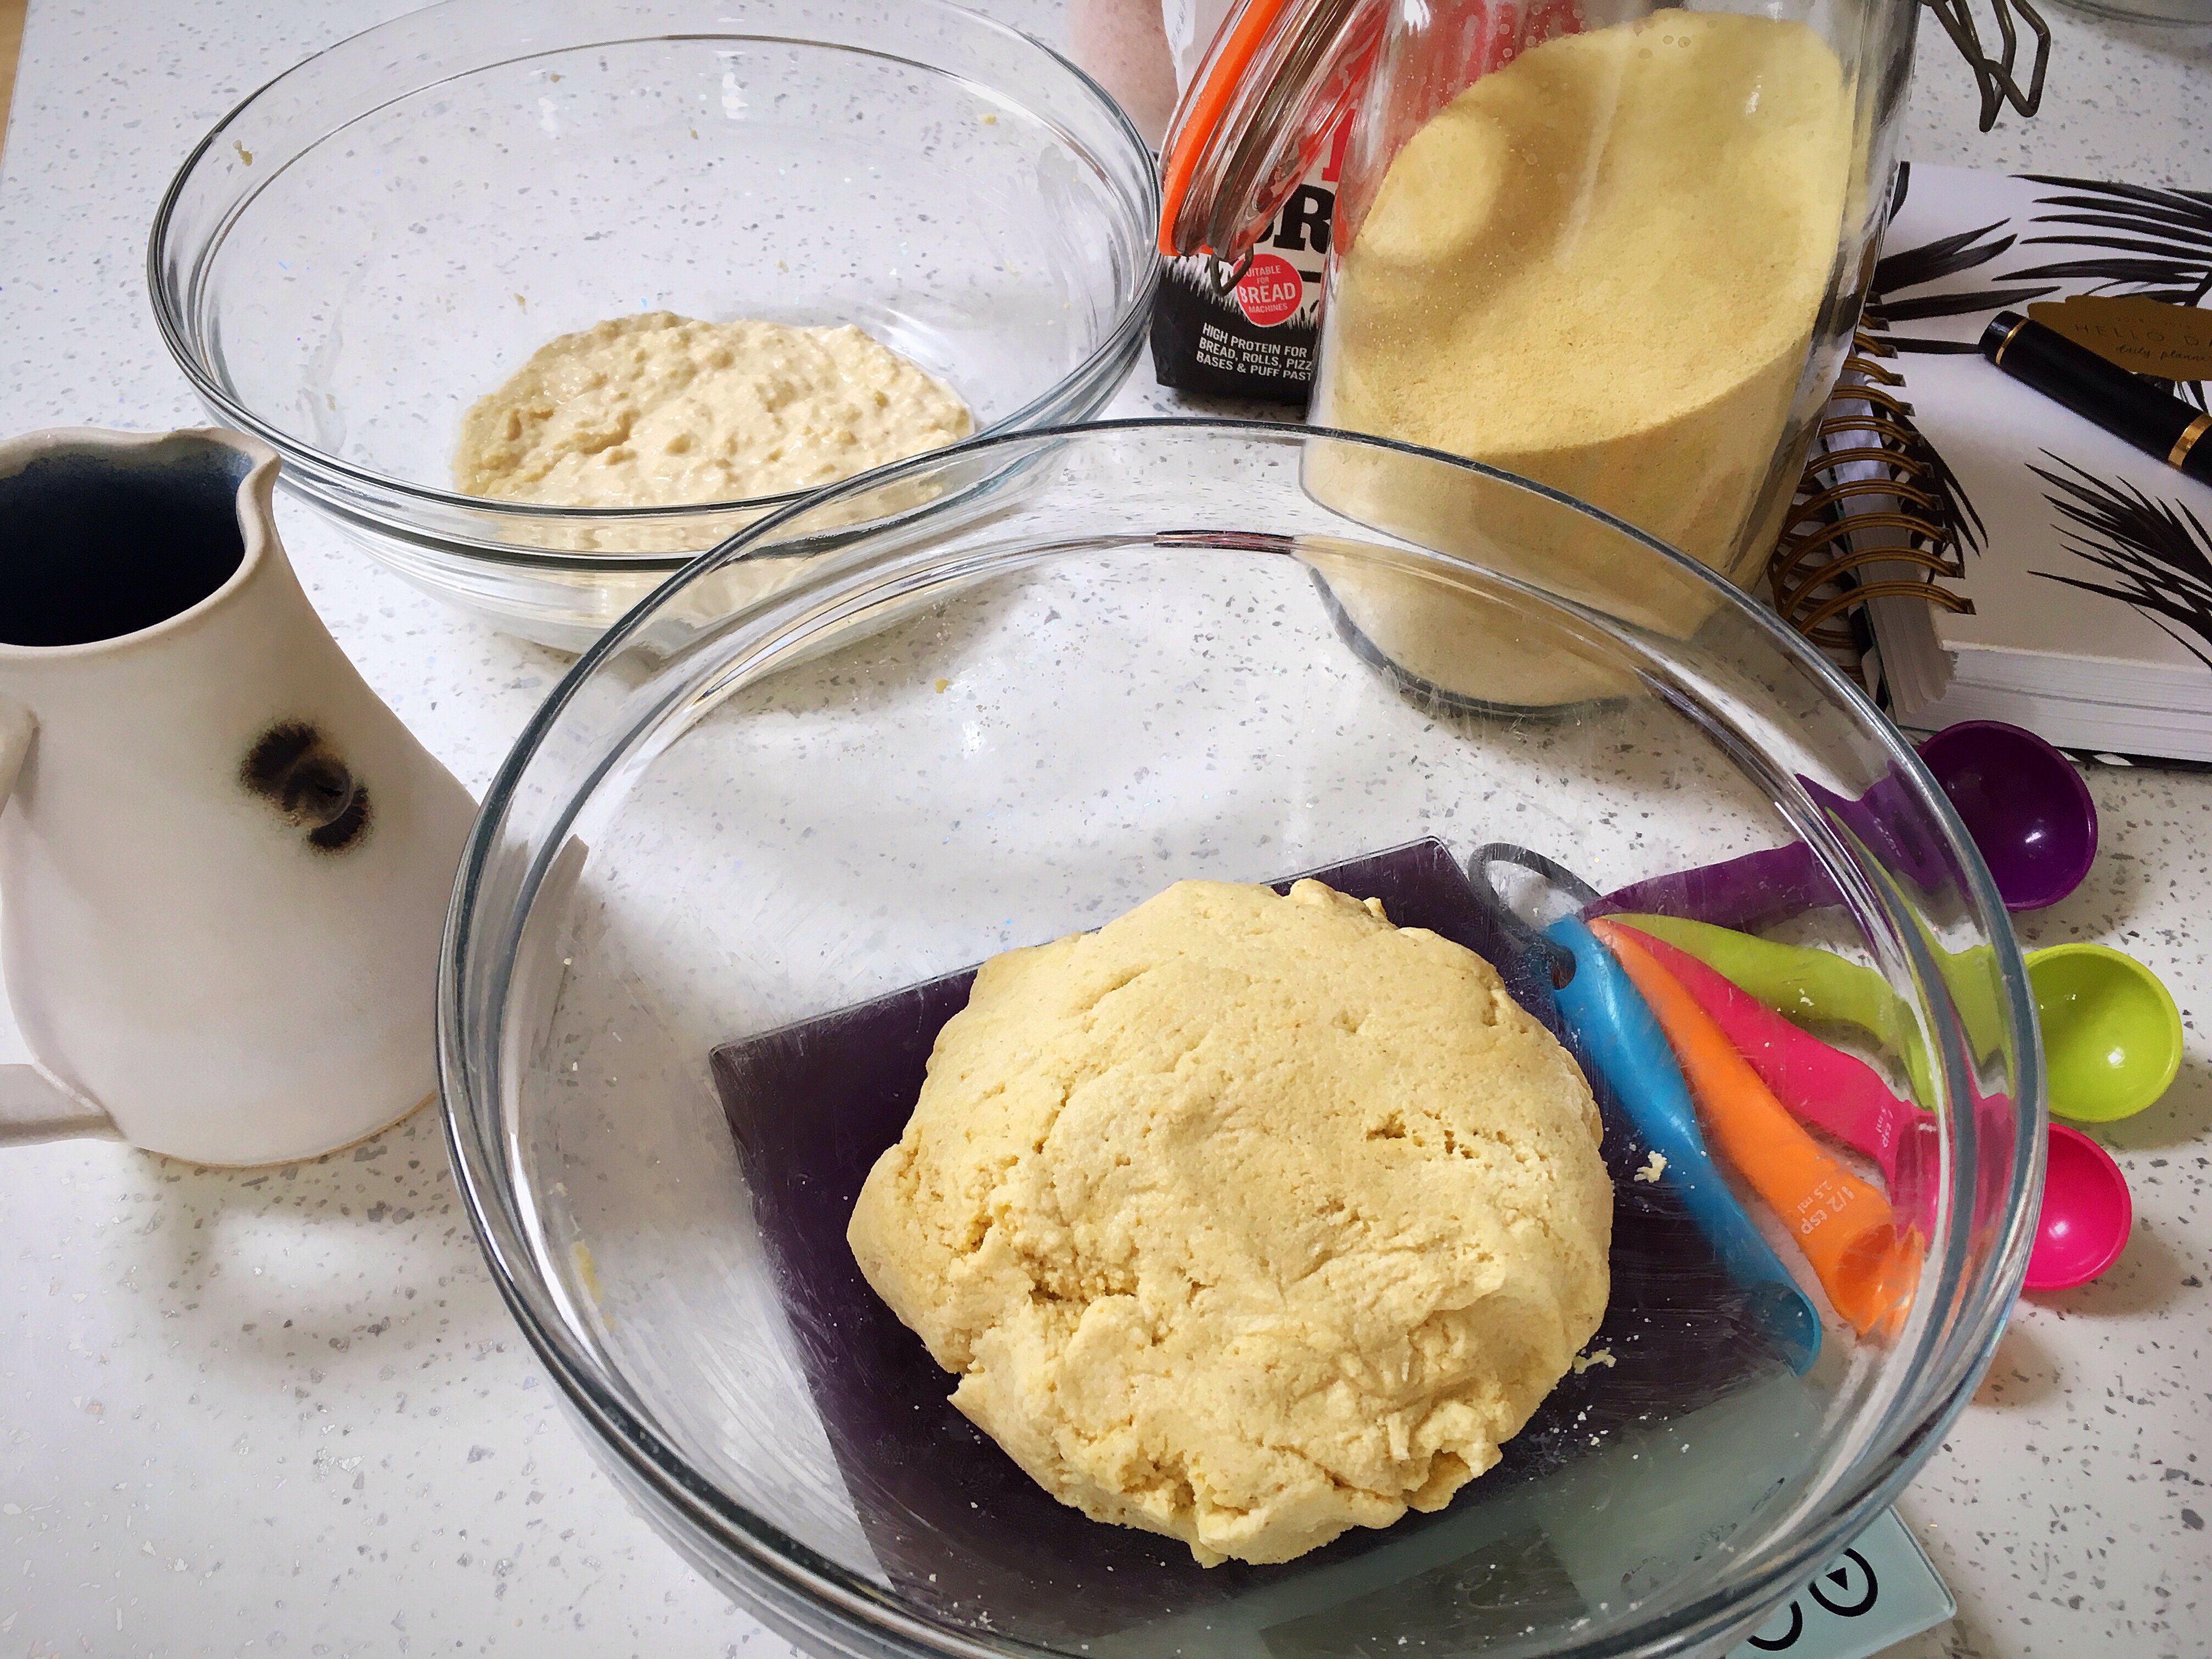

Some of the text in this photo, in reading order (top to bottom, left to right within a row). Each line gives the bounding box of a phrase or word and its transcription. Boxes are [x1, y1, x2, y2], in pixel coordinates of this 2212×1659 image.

[1246, 265, 1281, 277] UITABLE
[1256, 276, 1269, 285] FOR
[1239, 283, 1296, 304] BREAD
[1248, 303, 1288, 313] MACHINES
[1202, 323, 1307, 358] HIGH PROTEIN FOR
[2074, 323, 2165, 342] HELLO
[1199, 336, 1312, 371] BREAD, ROLLS, PIZZ
[1196, 351, 1311, 381] BASES & PUFF PAST
[1875, 1116, 1884, 1133] ml
[1882, 1122, 1892, 1148] tsp
[1797, 1180, 1833, 1215] 2.5 ml
[1800, 1186, 1855, 1234] 1/2 tsp
